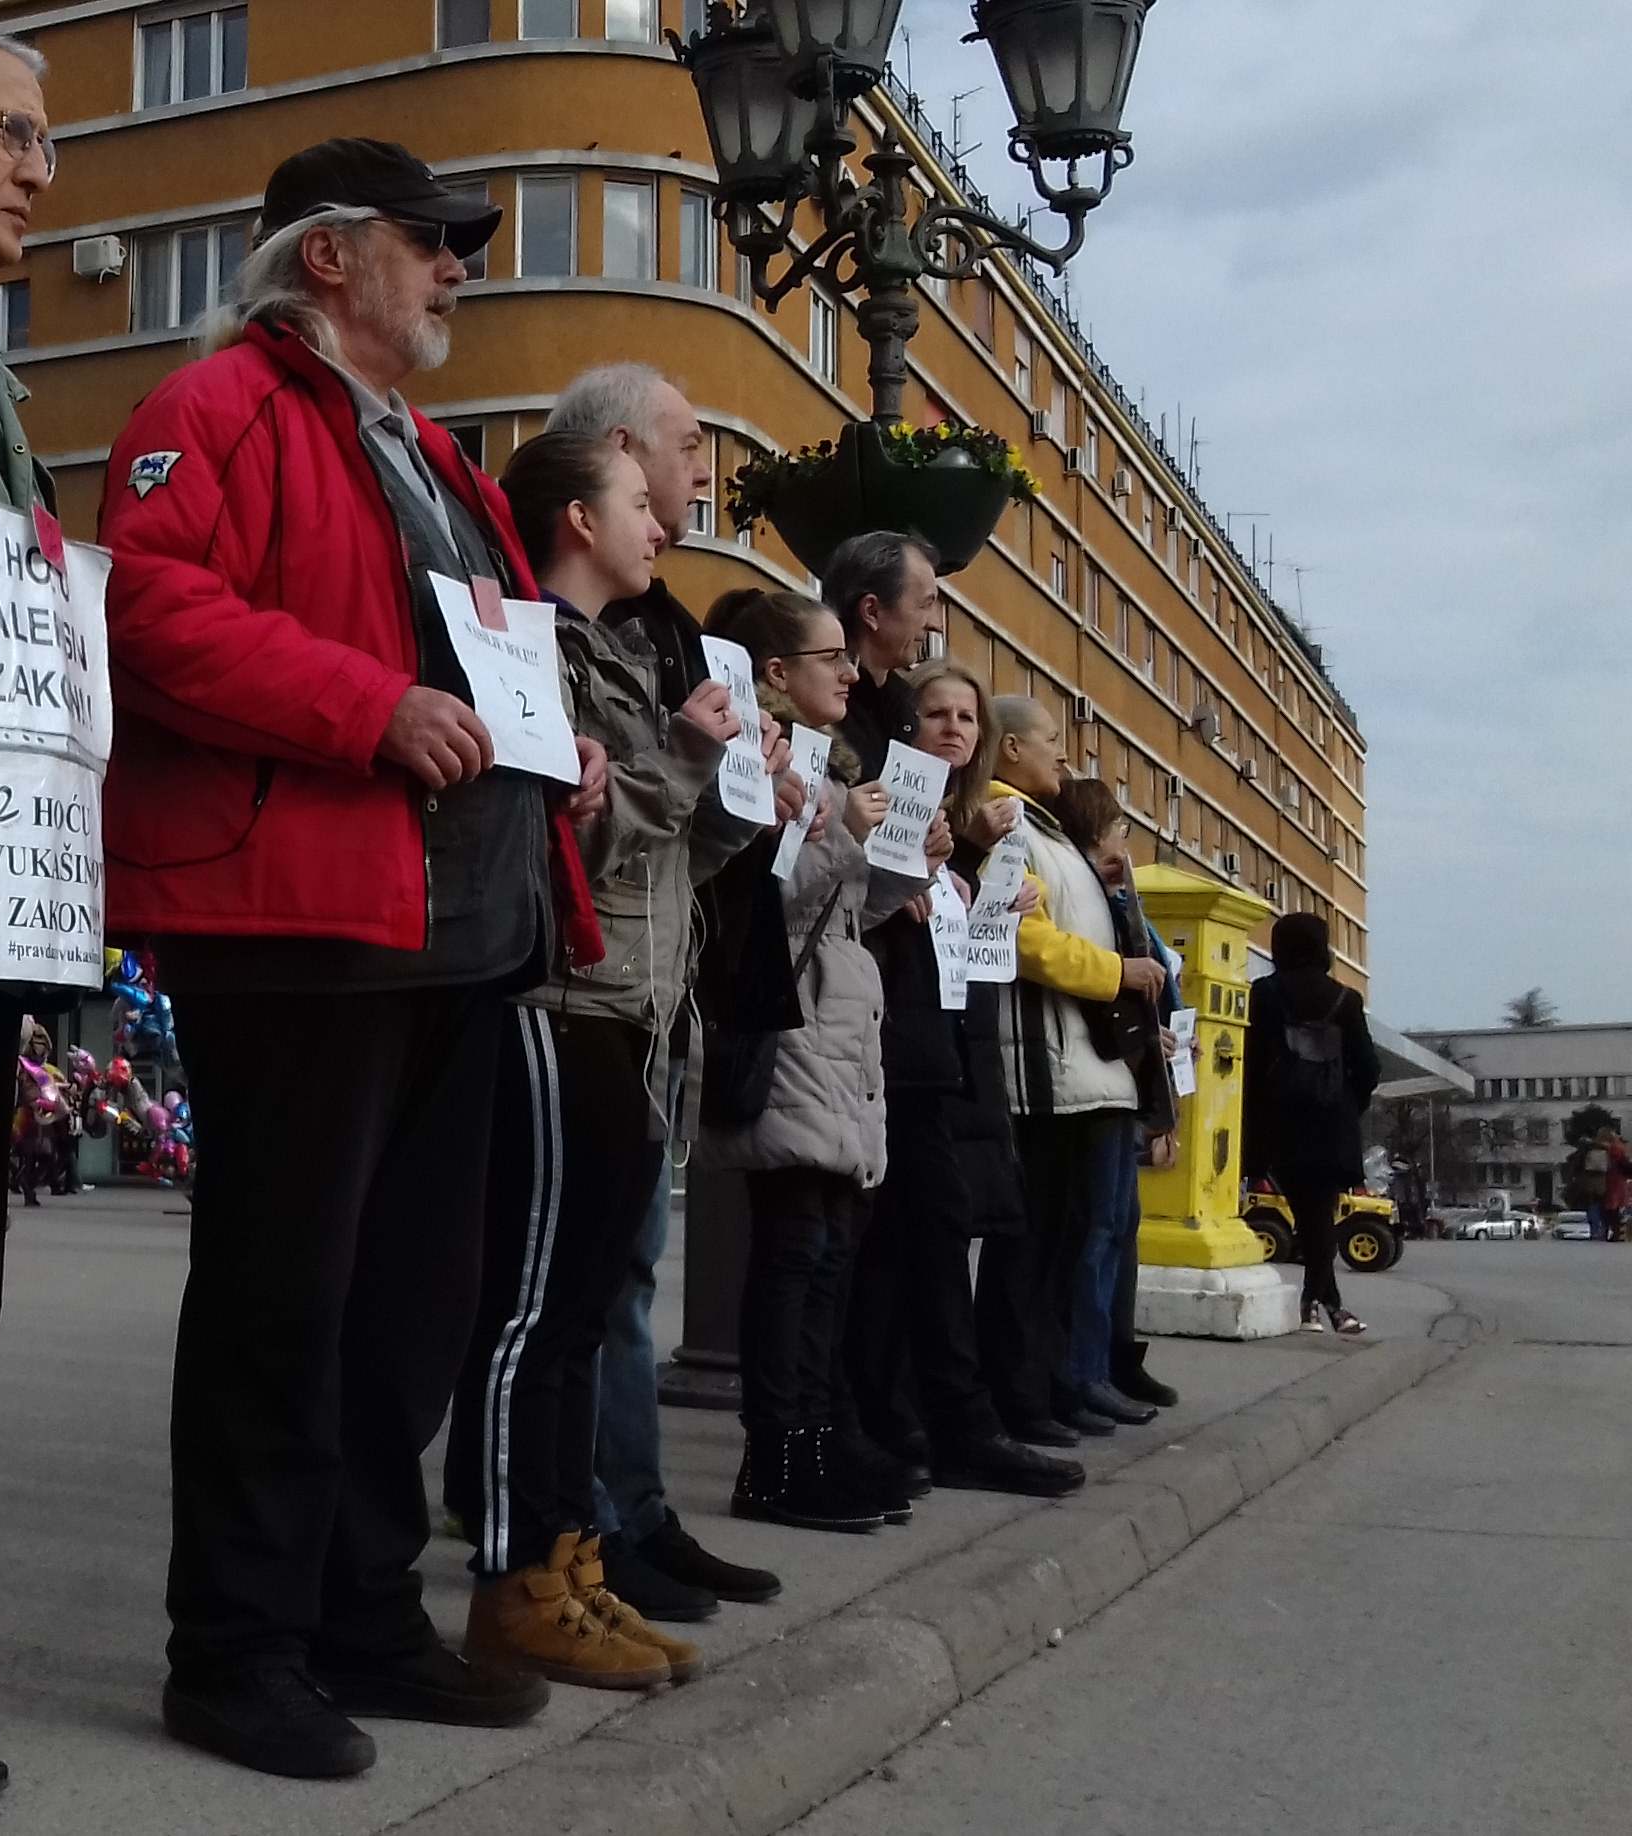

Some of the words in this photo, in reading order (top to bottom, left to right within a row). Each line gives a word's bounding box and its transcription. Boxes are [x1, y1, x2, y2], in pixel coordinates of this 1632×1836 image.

[515, 690, 535, 719] 2
[32, 793, 91, 836] HOĆU
[935, 914, 944, 934] 2
